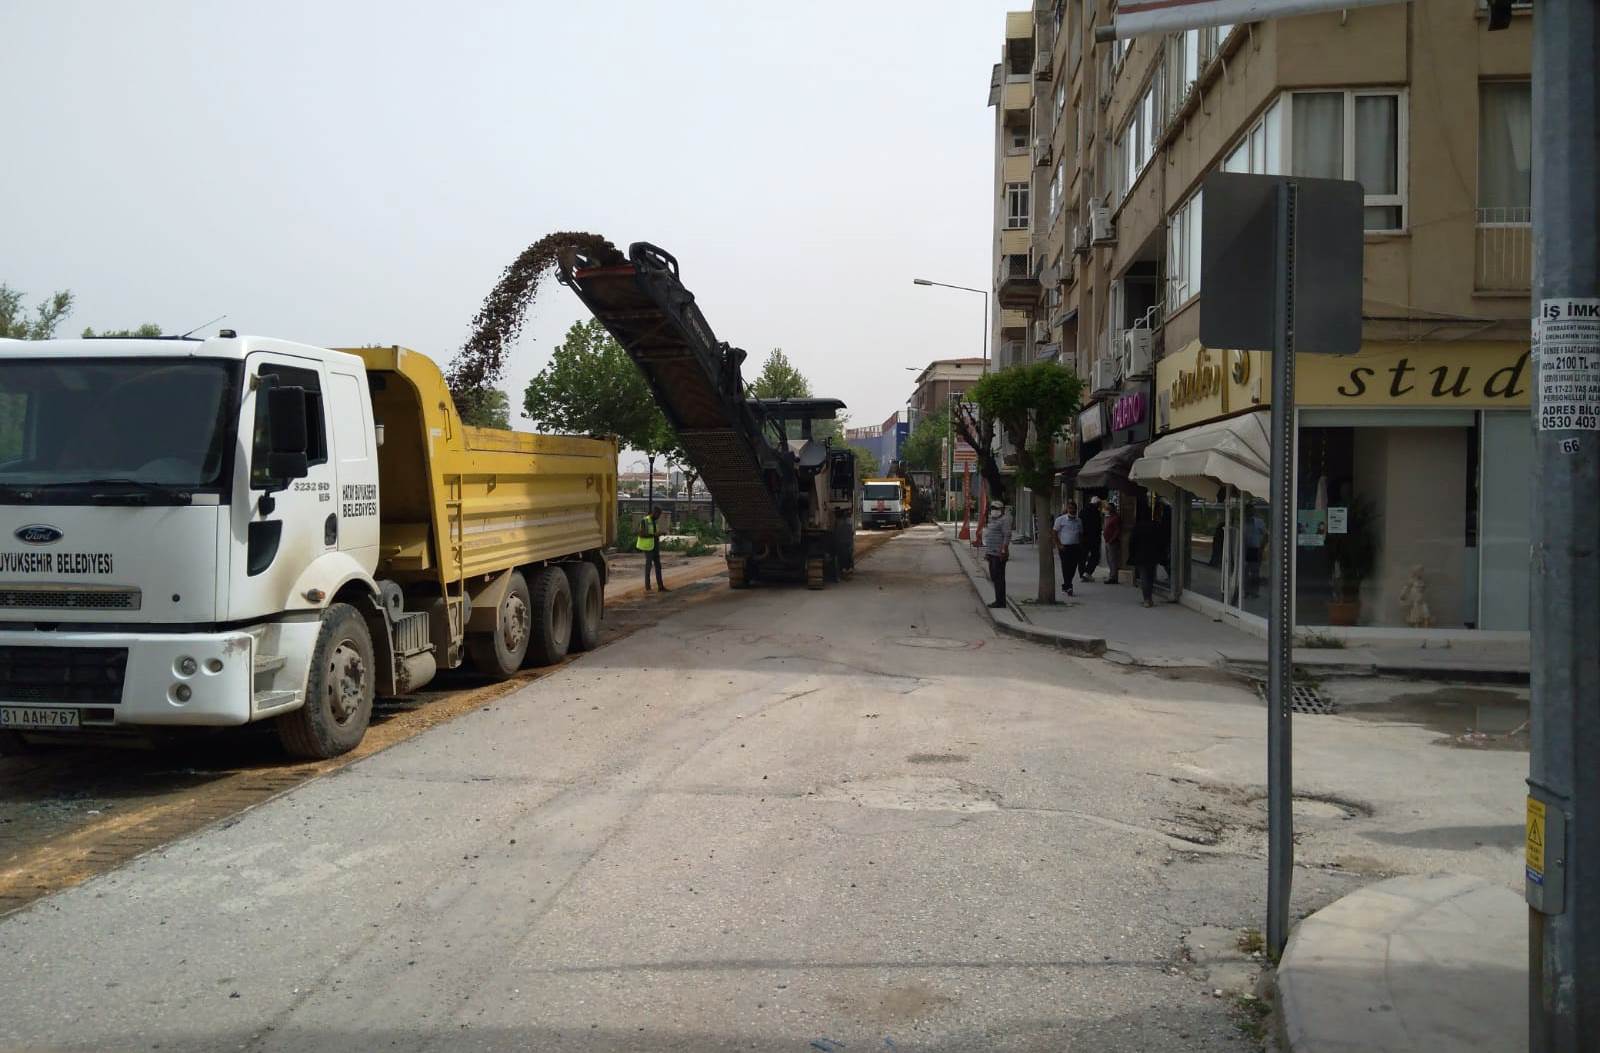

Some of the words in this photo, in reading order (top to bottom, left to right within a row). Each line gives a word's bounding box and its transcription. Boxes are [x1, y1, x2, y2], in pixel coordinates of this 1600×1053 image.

[1544, 303, 1560, 320] İŞ
[1556, 356, 1576, 369] 2100
[1579, 356, 1588, 369] TL
[1544, 385, 1552, 393] VE
[1543, 405, 1575, 415] ADRES
[1542, 416, 1571, 428] 0530
[1575, 416, 1596, 428] 403
[1563, 440, 1580, 453] 66
[294, 482, 316, 491] 3232
[25, 528, 52, 540] Ford
[3, 709, 16, 723] 31
[23, 710, 47, 724] AAH
[51, 711, 76, 725] 767
